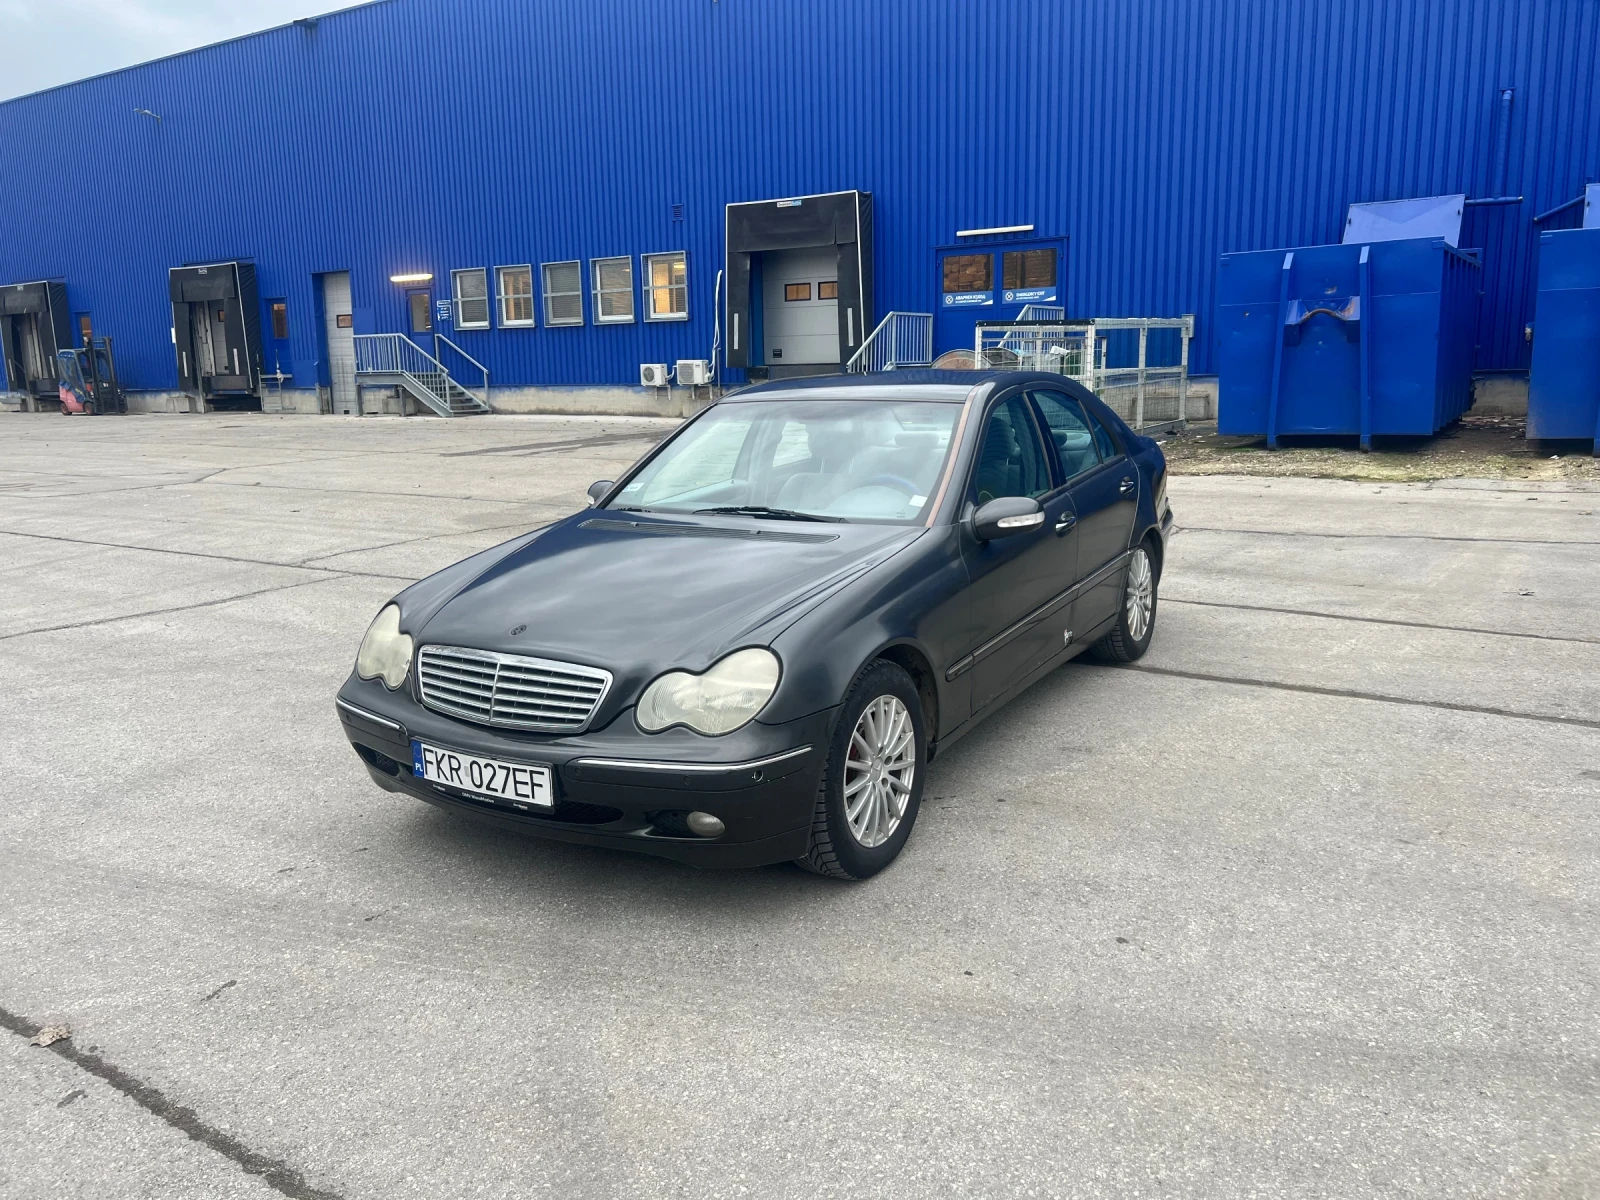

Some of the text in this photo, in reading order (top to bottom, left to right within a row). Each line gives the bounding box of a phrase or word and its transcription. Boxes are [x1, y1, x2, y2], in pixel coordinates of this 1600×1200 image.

[415, 763, 423, 772] PL
[423, 747, 545, 799] FKR 027EF
